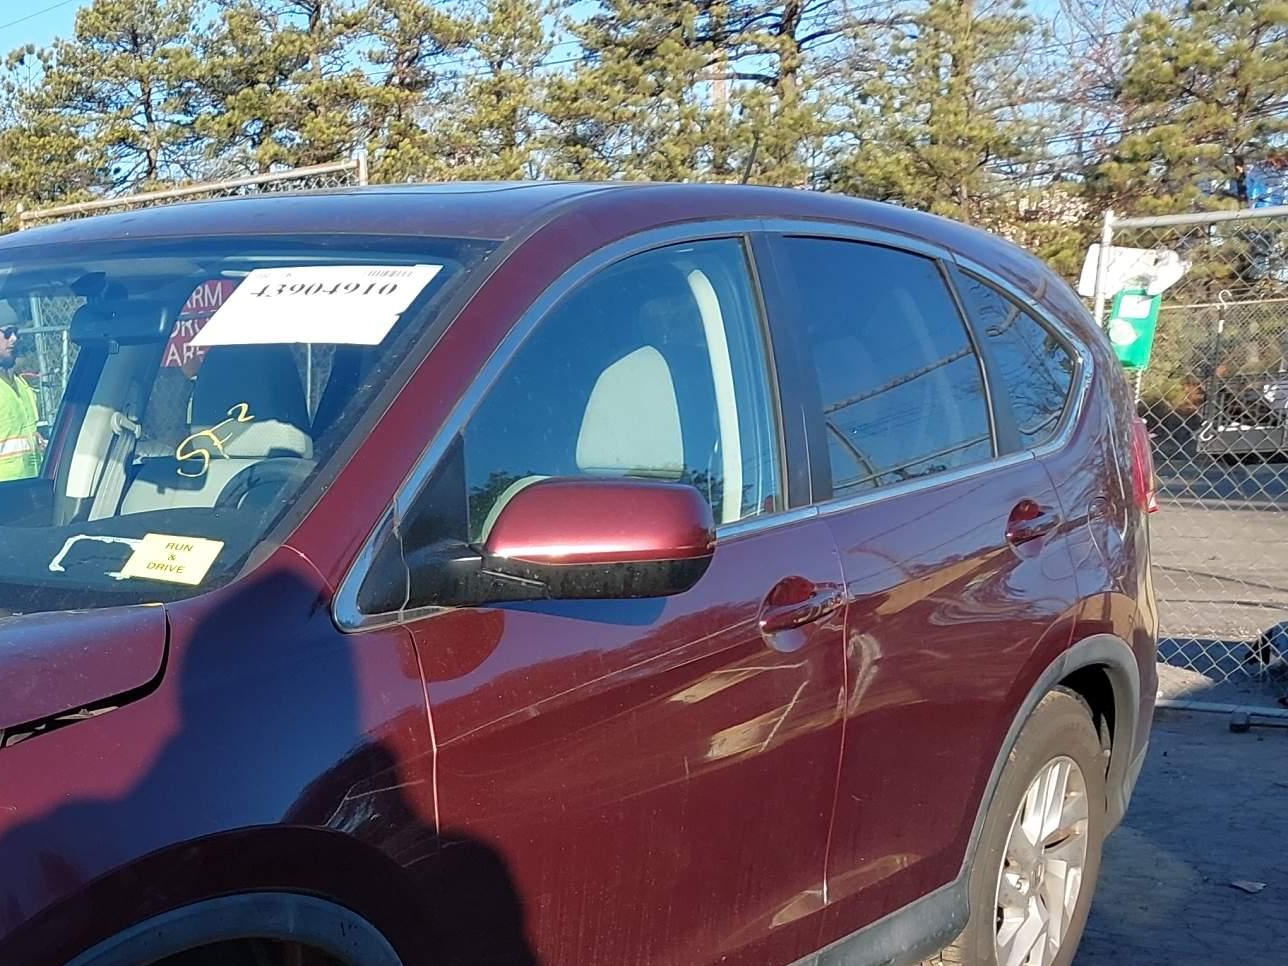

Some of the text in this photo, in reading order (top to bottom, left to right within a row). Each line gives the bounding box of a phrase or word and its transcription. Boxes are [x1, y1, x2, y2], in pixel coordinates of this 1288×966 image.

[250, 281, 399, 298] 43904910
[165, 542, 194, 552] RUN
[146, 561, 186, 574] DRIVE
